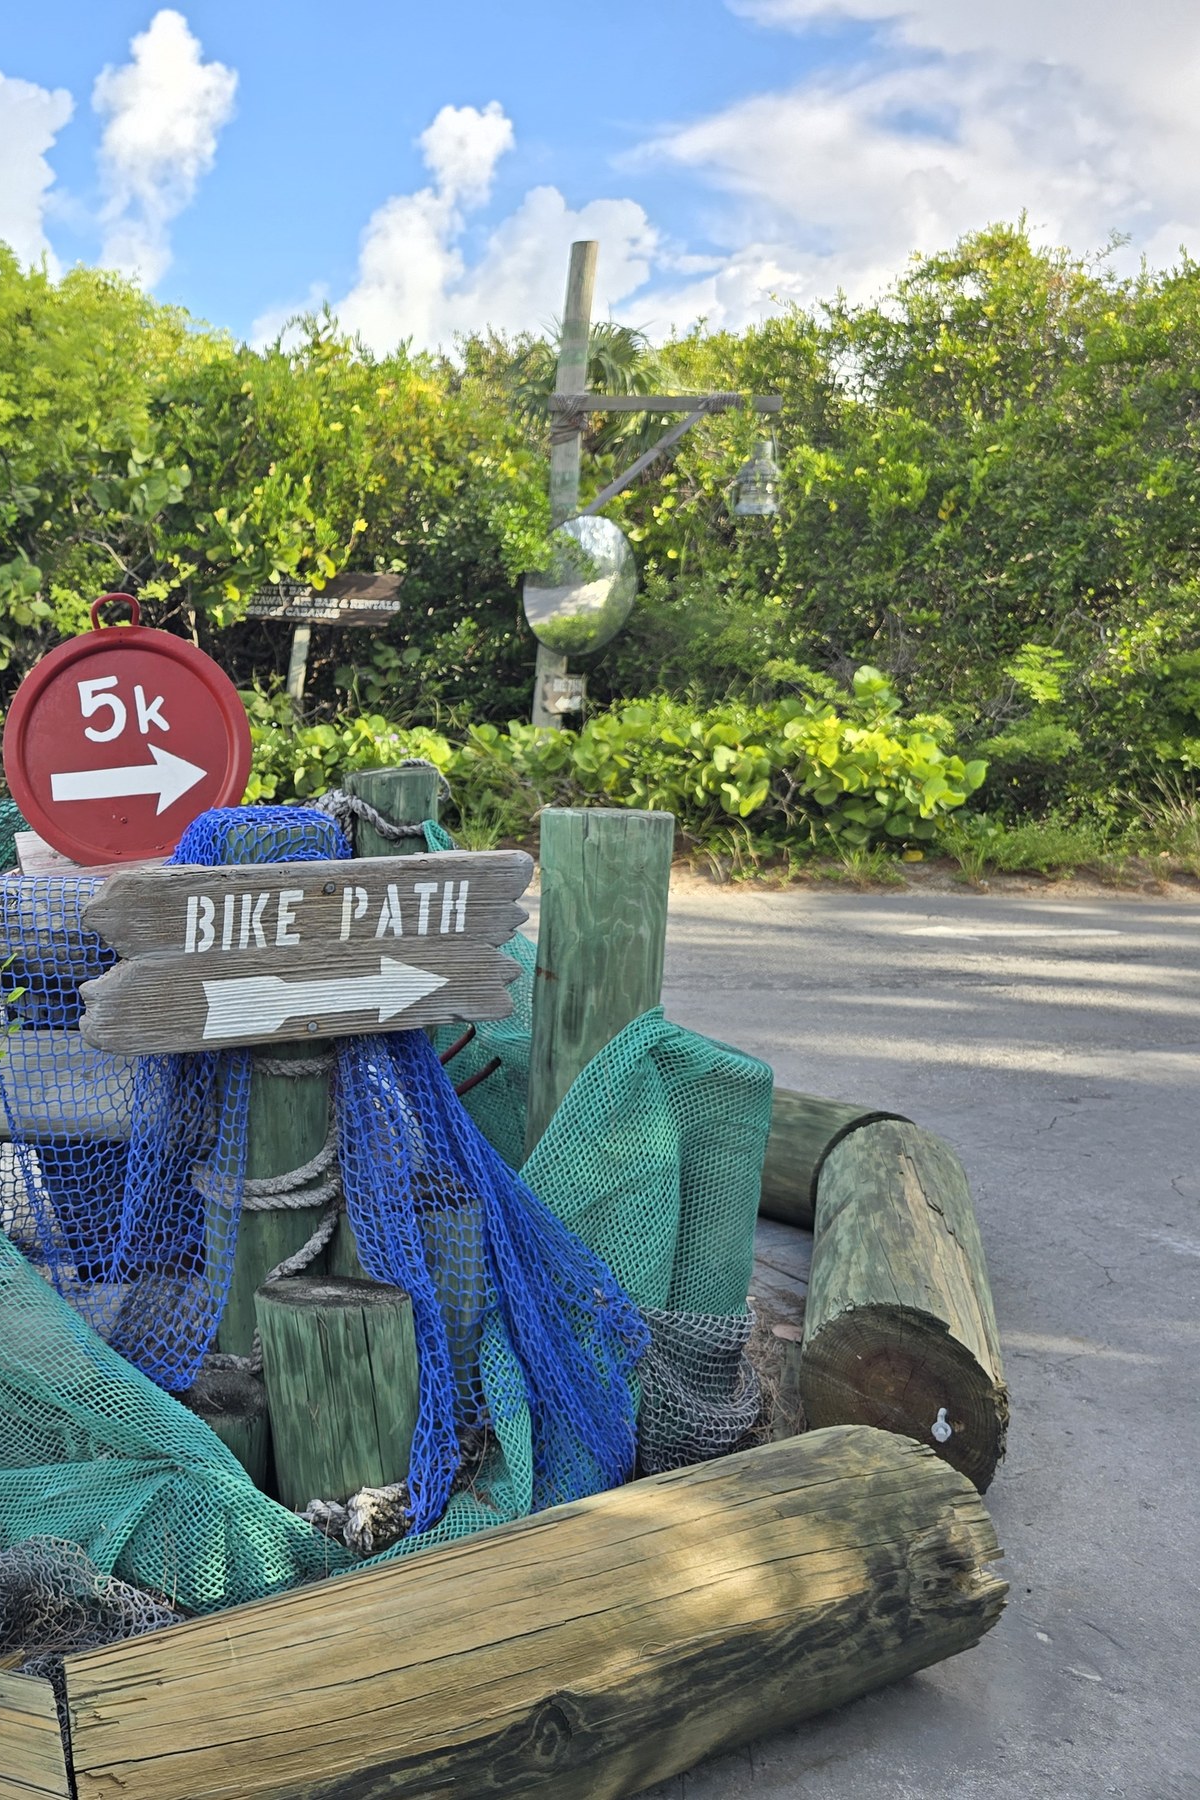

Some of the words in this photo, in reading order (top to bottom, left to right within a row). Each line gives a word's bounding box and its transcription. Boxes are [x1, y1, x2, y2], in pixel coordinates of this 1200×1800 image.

[313, 597, 339, 608] BAR
[350, 599, 400, 610] RENTALS
[247, 605, 284, 616] SSAGE
[285, 606, 340, 618] CABANAS
[184, 889, 304, 953] BIKE
[339, 880, 469, 941] PATH
